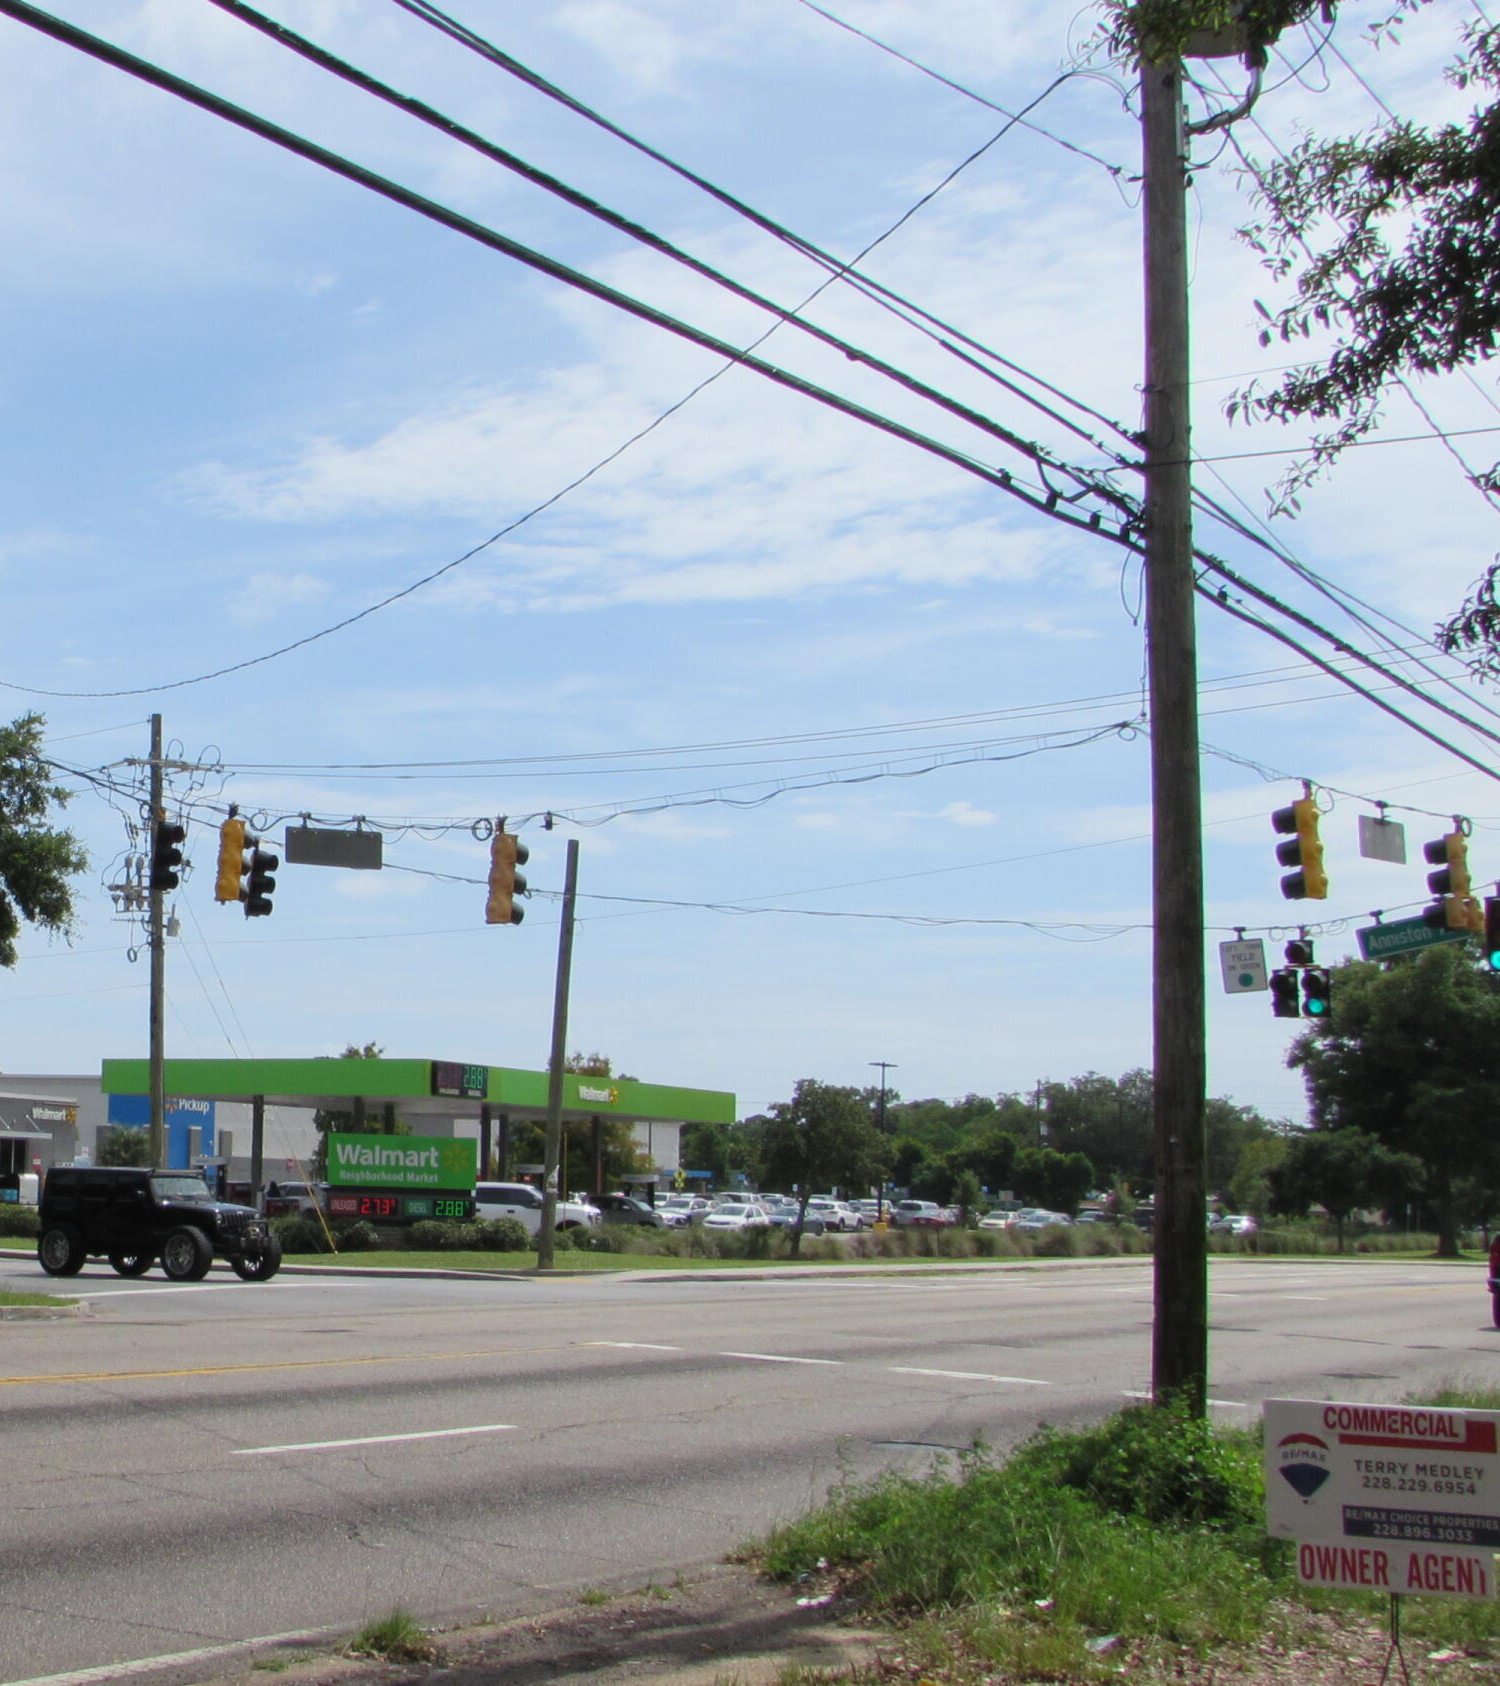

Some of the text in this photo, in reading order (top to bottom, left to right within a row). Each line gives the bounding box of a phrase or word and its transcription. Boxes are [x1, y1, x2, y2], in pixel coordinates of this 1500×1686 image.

[1369, 926, 1433, 950] Anniston
[32, 1106, 67, 1121] Walmart
[179, 1098, 209, 1115] Pickup
[336, 1143, 439, 1168] Walmart
[340, 1170, 438, 1183] Neighborhood Market
[1323, 1406, 1460, 1438] COMMERCIAL
[1282, 1449, 1326, 1461] RE/MAX
[1354, 1459, 1484, 1480] TERRY MEDLEY
[1362, 1476, 1477, 1495] 228.229.6954
[1345, 1507, 1499, 1530] RE/MAX CHOICE PROPERTIES
[1373, 1523, 1474, 1542] 228.896.3033
[1300, 1544, 1390, 1586] OWNER
